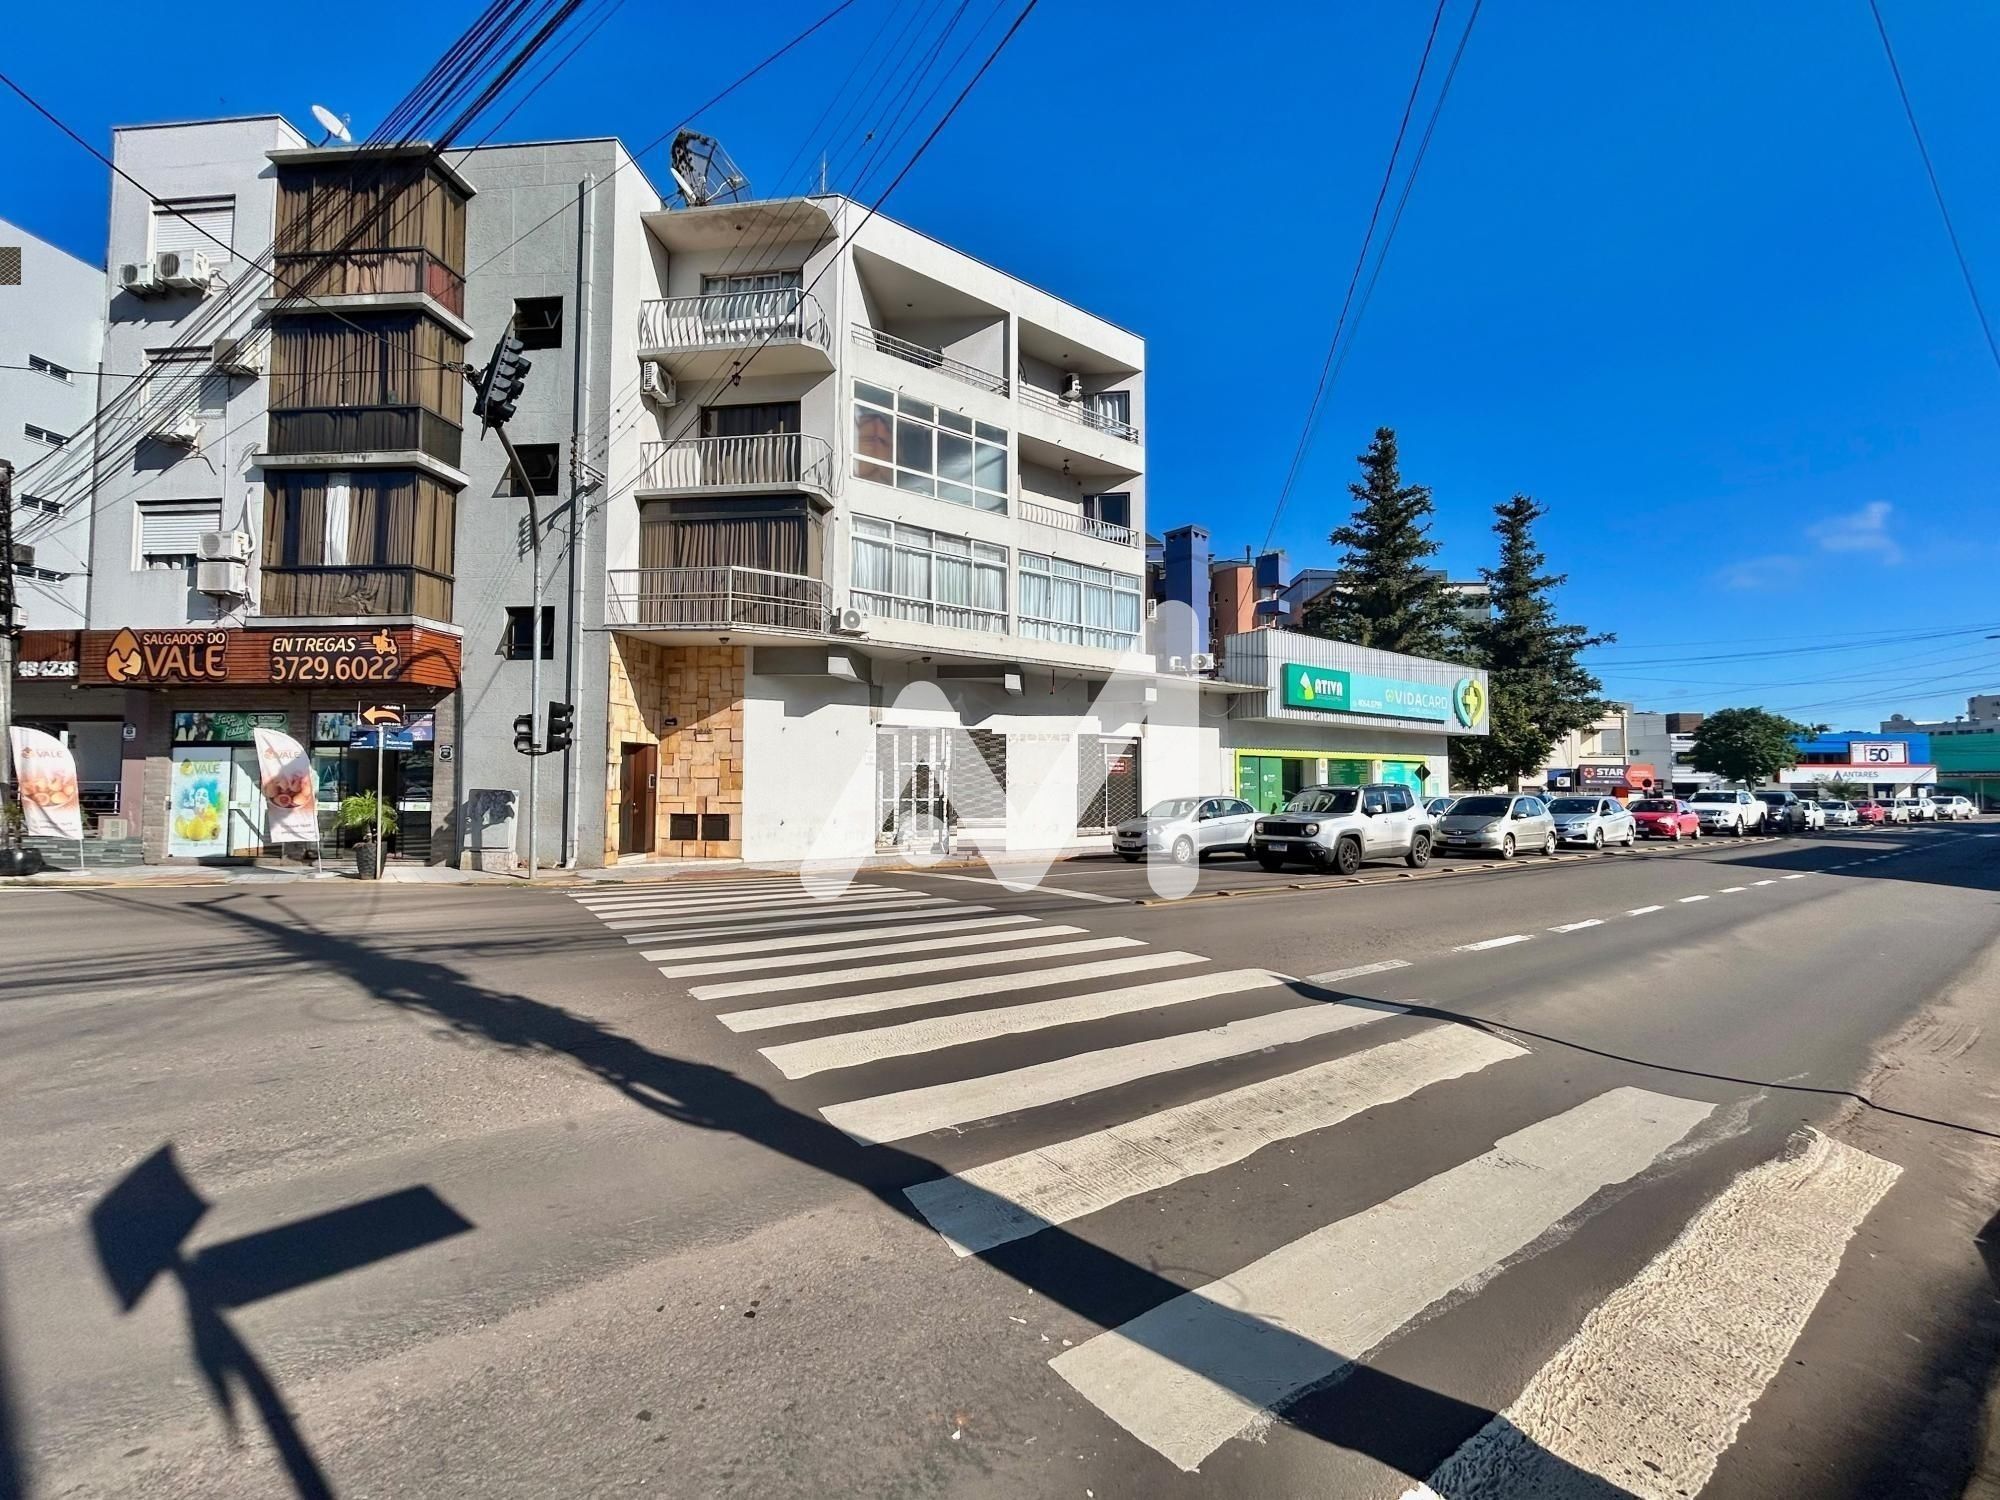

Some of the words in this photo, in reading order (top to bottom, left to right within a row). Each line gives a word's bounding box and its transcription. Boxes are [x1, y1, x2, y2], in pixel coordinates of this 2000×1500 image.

[143, 633, 204, 645] SALGADOS
[207, 632, 226, 645] DO
[272, 637, 357, 652] ENTREGAS
[143, 645, 226, 678] VALE
[271, 655, 399, 680] 3729.6022
[1314, 679, 1343, 697] ATIVA
[1393, 691, 1448, 709] VIDACARD
[36, 750, 64, 758] VALE
[278, 751, 301, 759] VALE
[1868, 748, 1890, 762] 50
[193, 762, 221, 773] VALE
[1596, 767, 1624, 776] STAR
